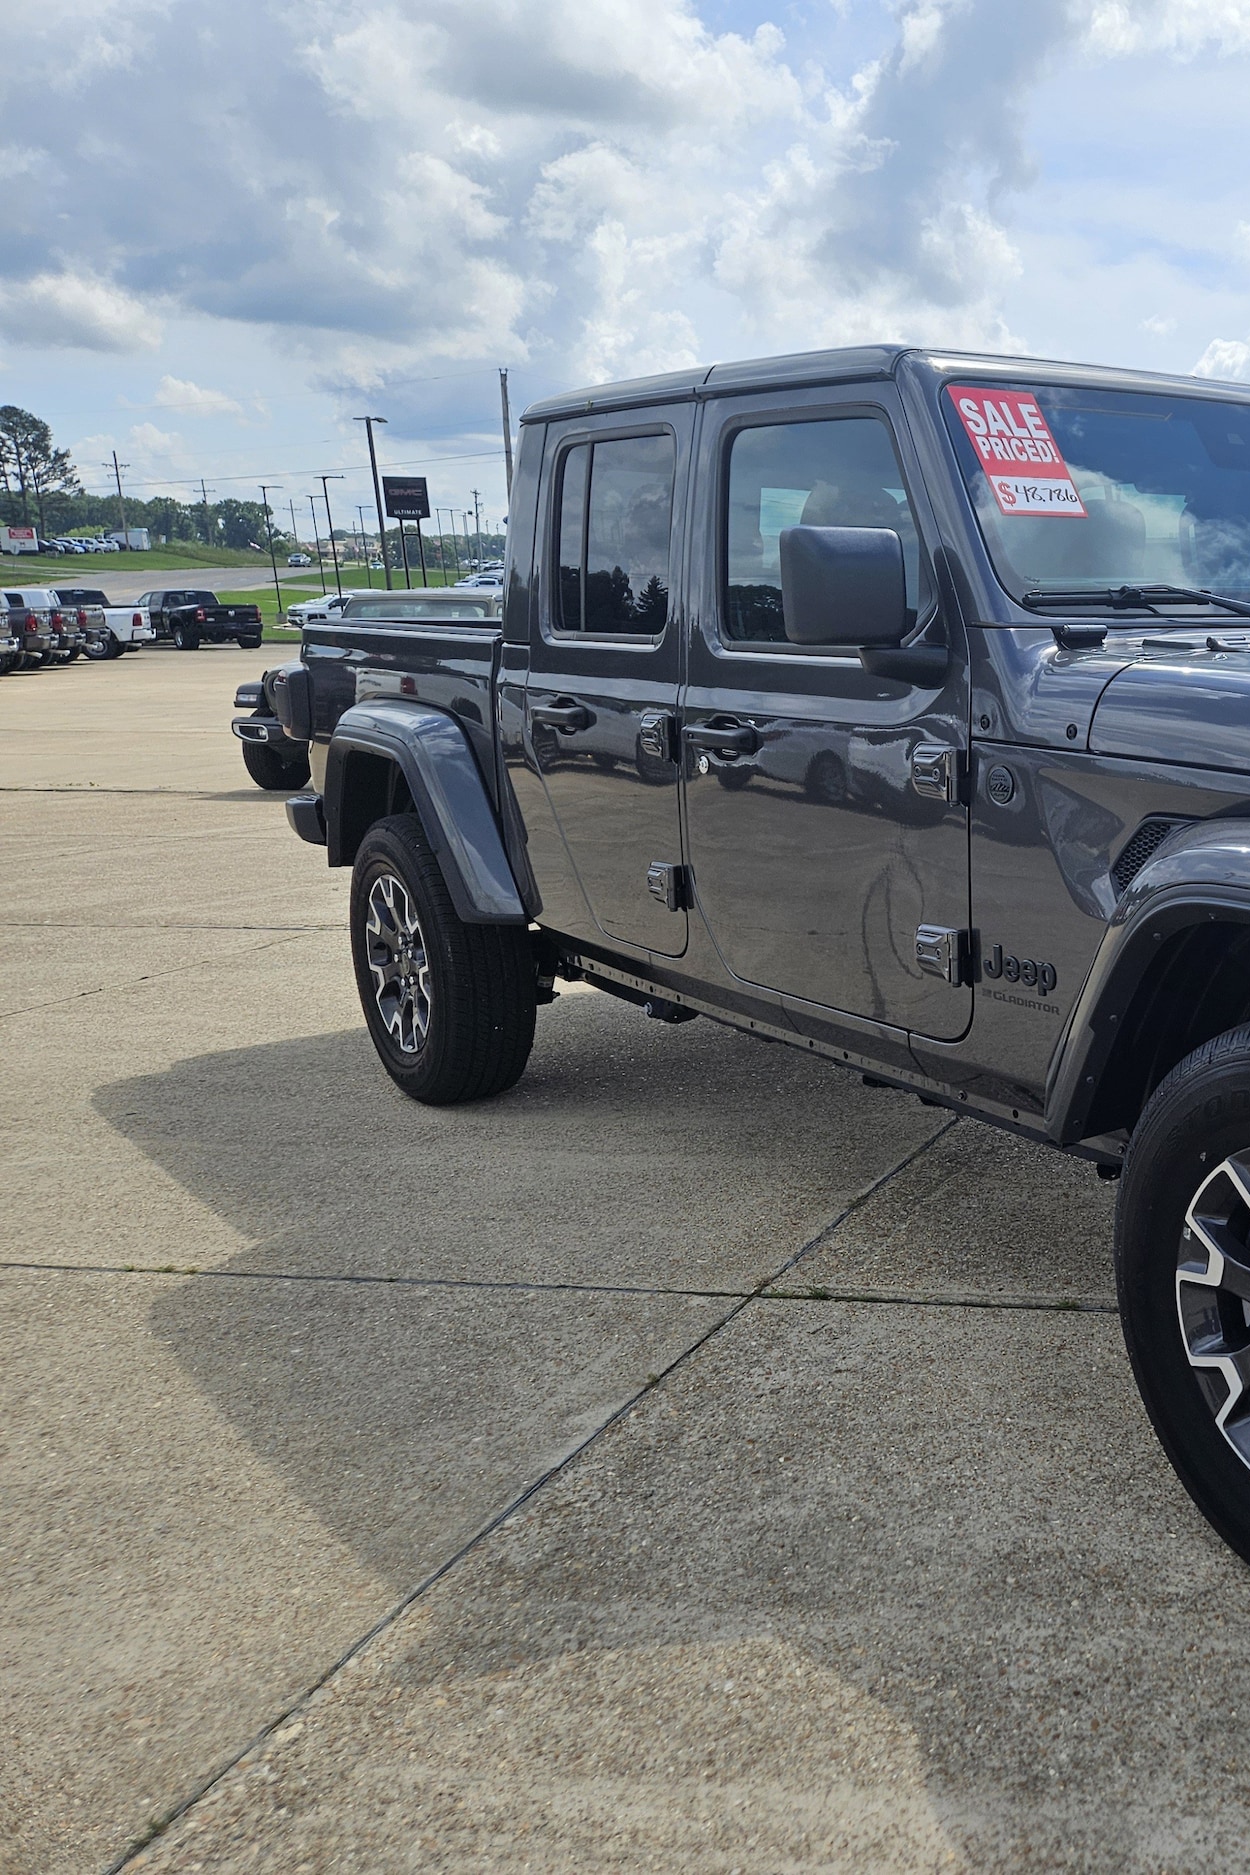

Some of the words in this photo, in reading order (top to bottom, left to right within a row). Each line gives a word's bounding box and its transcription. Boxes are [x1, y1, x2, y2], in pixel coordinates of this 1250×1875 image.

[959, 398, 1050, 440] SALE
[975, 435, 1061, 464] PRICED!
[388, 488, 423, 496] GMC
[983, 943, 1058, 997] Jeep
[993, 990, 1061, 1016] GLADIATOR
